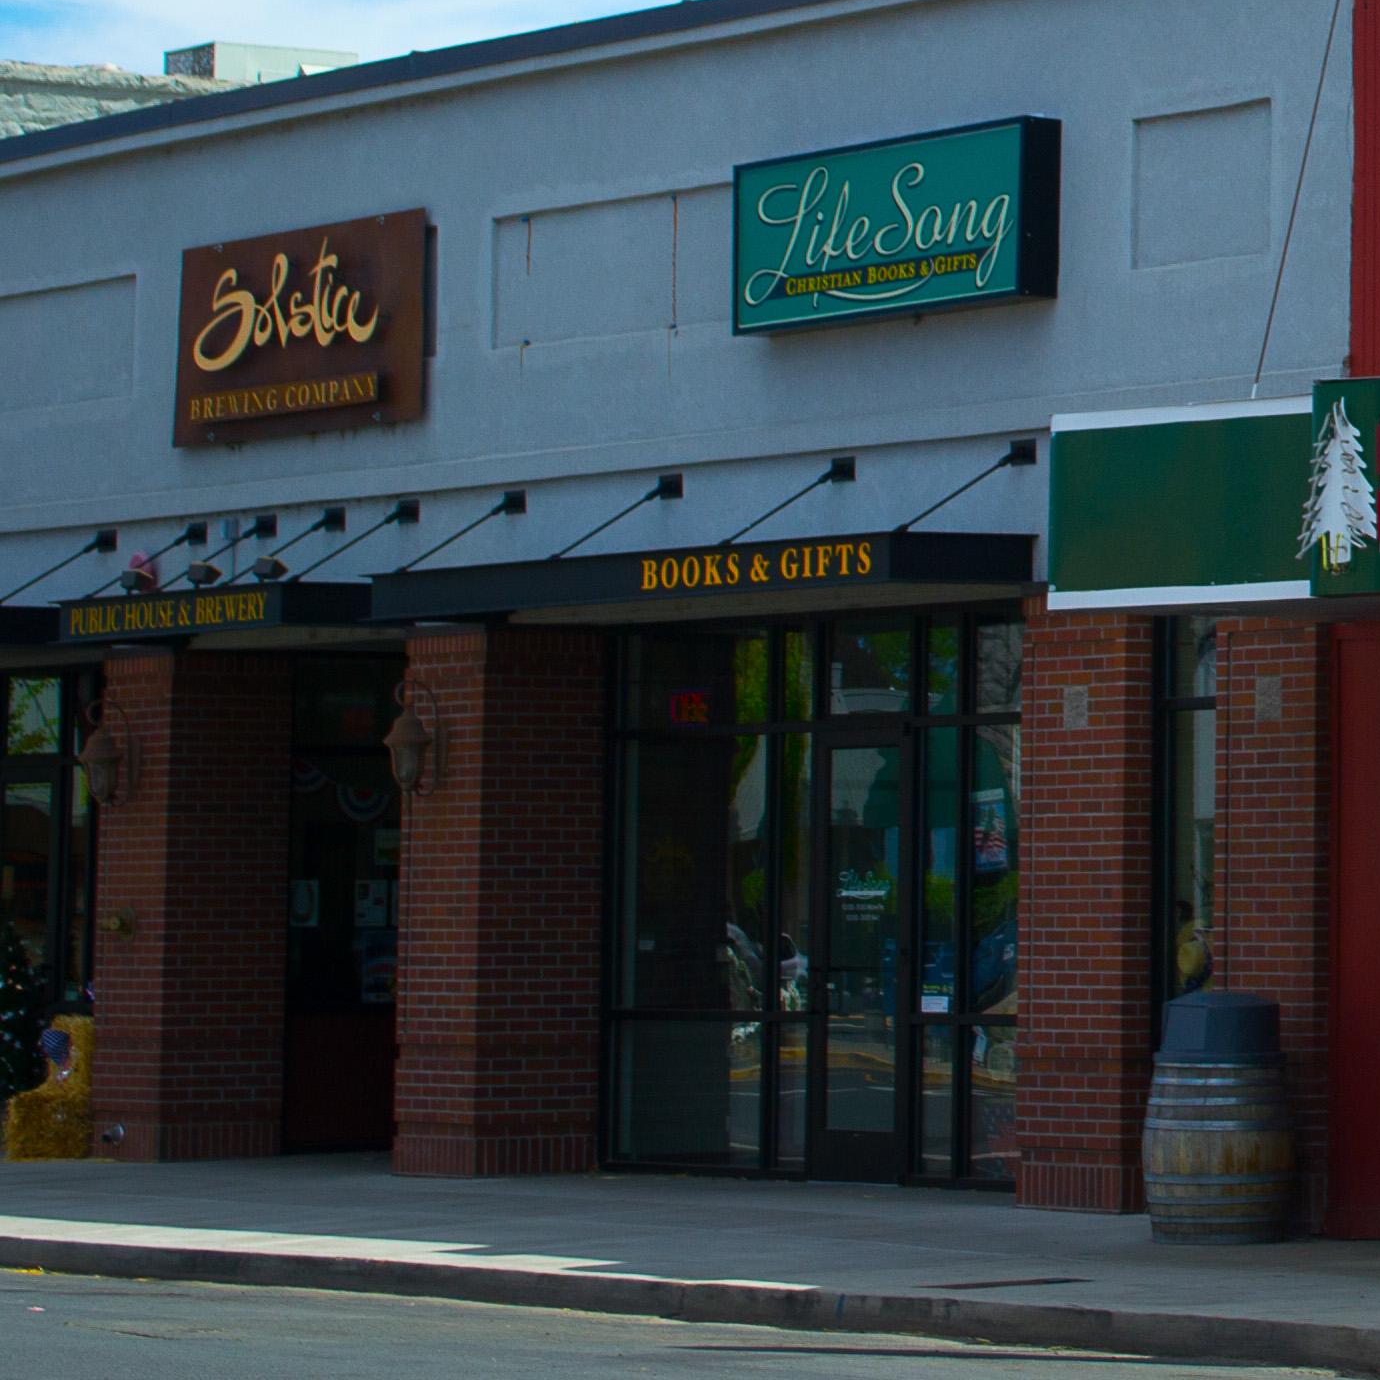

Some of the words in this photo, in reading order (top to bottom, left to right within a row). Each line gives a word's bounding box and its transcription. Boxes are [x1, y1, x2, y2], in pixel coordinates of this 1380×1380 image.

[786, 269, 861, 295] CHRISTIAN
[867, 262, 916, 285] BOOKS
[934, 254, 977, 275] GIFTS
[193, 236, 379, 371] Solstice
[190, 388, 278, 421] BREWING
[285, 372, 377, 409] COMPANY
[640, 553, 741, 591] BOOKS
[750, 552, 770, 582] &
[780, 541, 872, 580] GIFTS
[70, 604, 122, 636] PUBLIC
[125, 599, 175, 630] HOUSE
[178, 598, 192, 627] &
[195, 592, 267, 625] BREWERY
